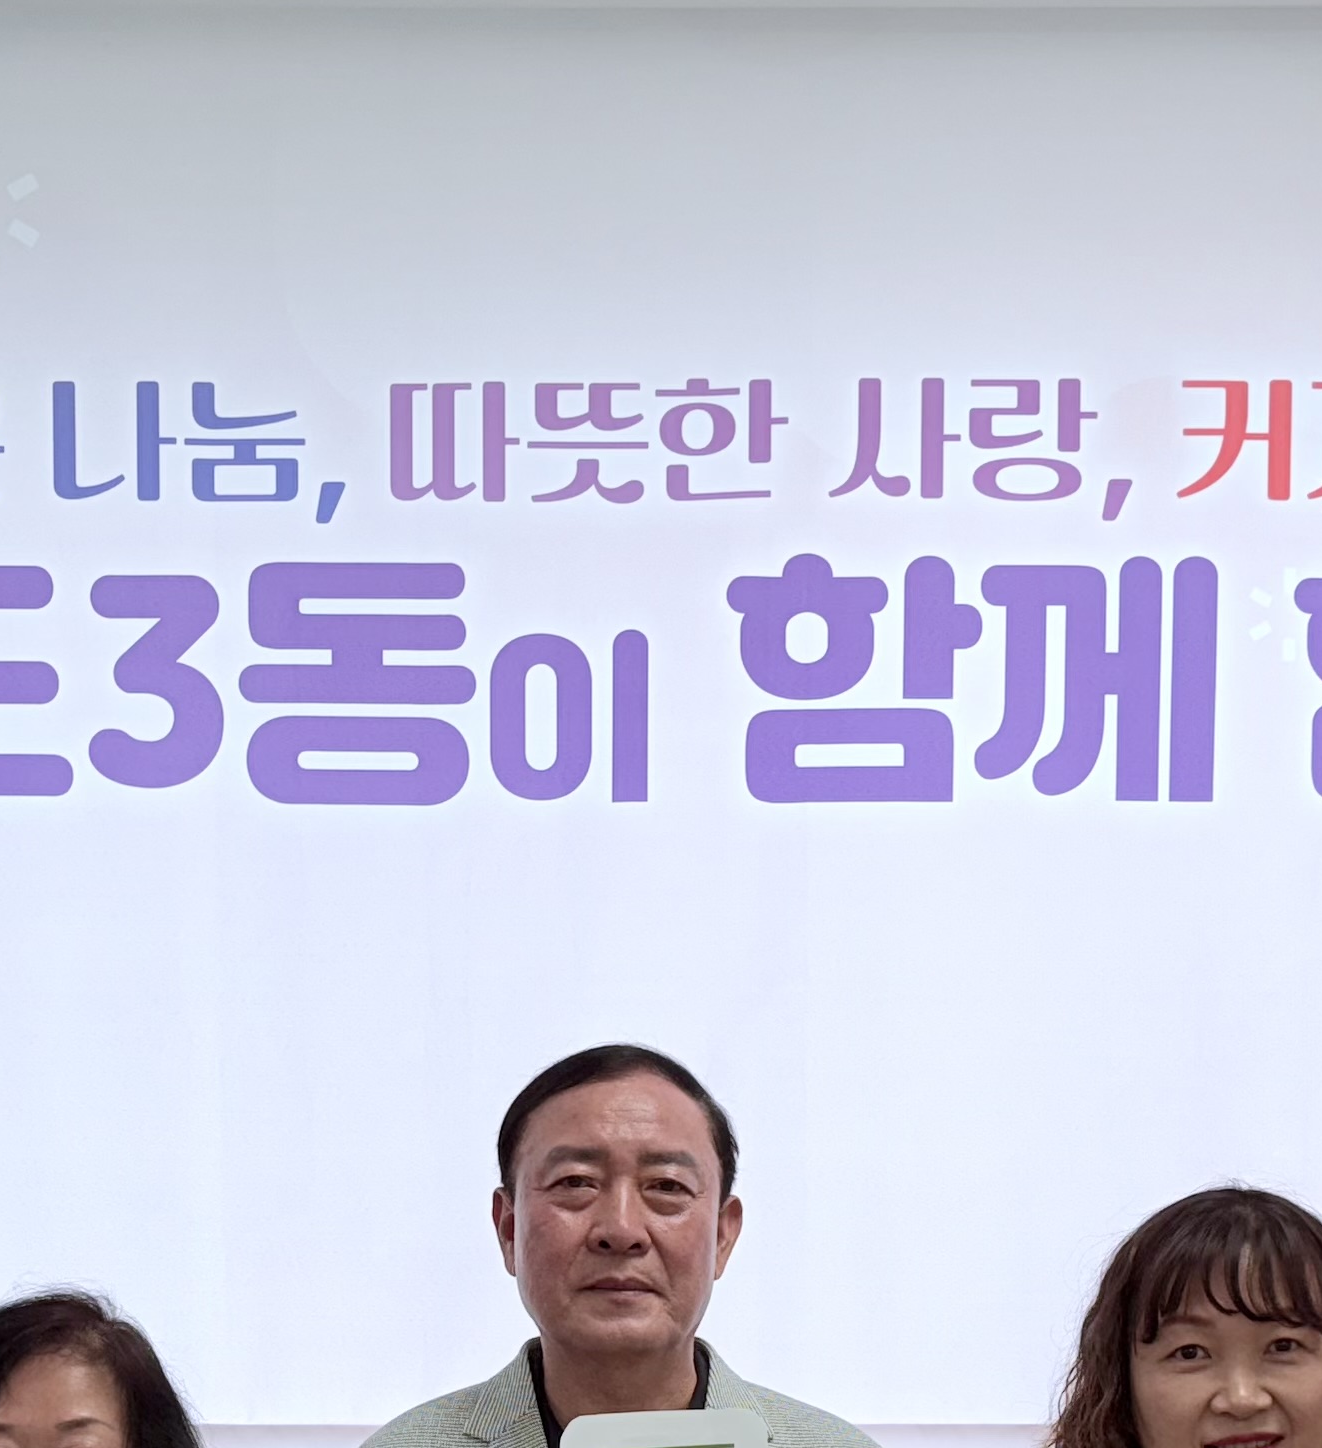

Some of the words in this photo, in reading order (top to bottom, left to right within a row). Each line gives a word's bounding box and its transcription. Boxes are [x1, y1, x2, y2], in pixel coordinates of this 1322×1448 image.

[52, 380, 346, 524] 나눔,
[389, 377, 790, 505] 따뜻한
[828, 377, 1133, 522] 사랑,
[725, 552, 1219, 804] 함께
